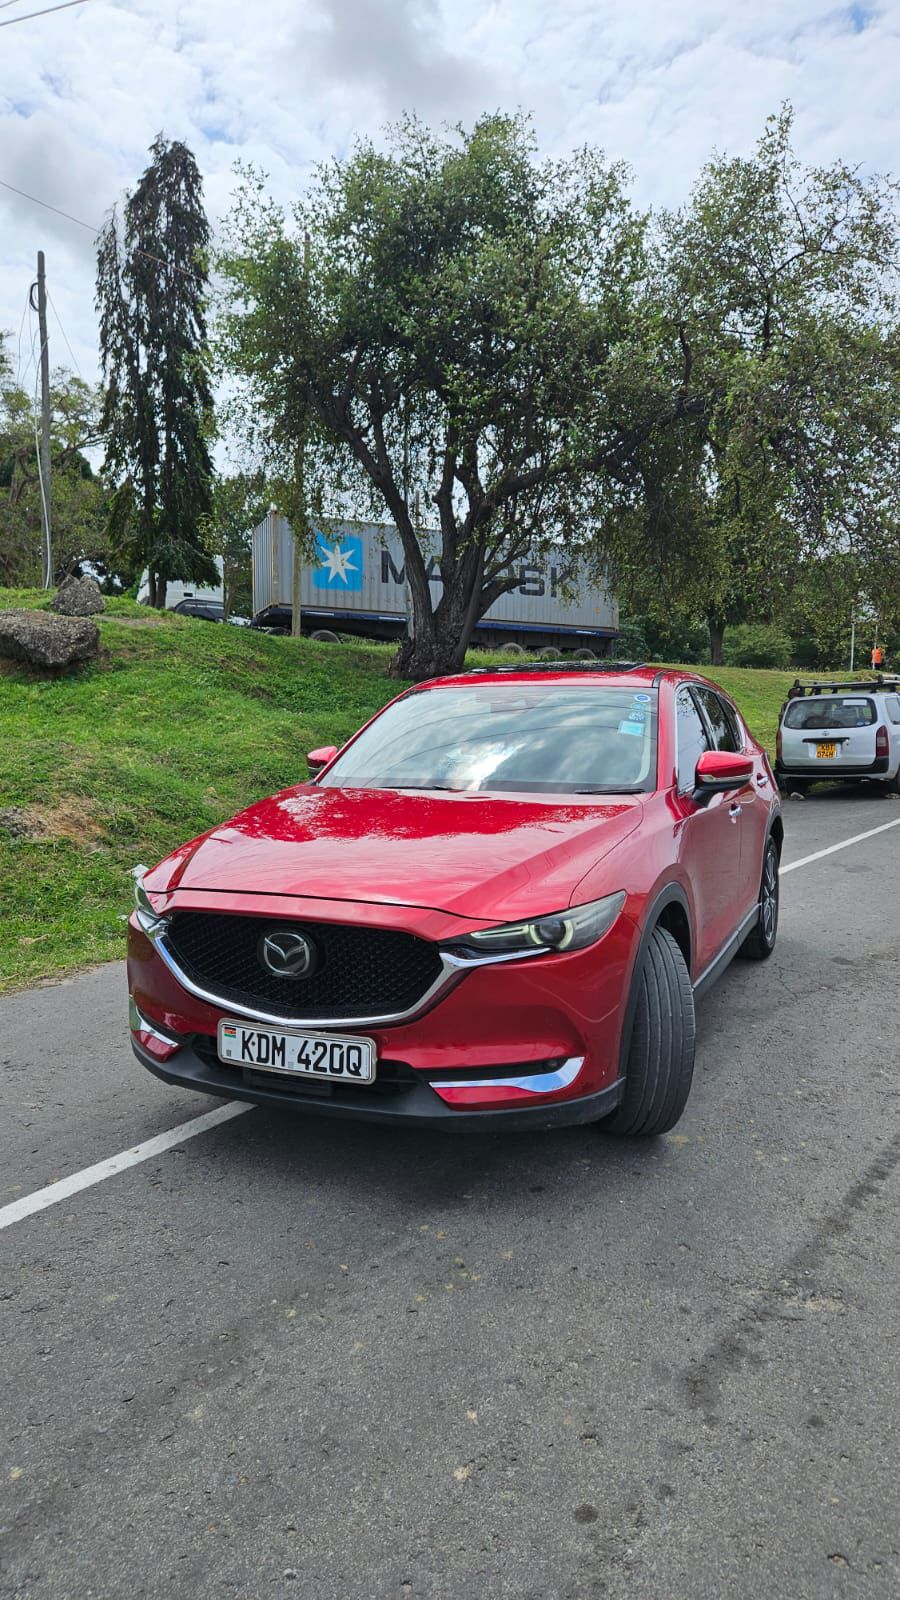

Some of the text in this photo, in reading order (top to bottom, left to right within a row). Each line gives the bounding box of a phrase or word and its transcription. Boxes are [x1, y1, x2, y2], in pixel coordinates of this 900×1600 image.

[381, 551, 572, 597] MASK
[241, 1030, 362, 1076] KDM 420Q
